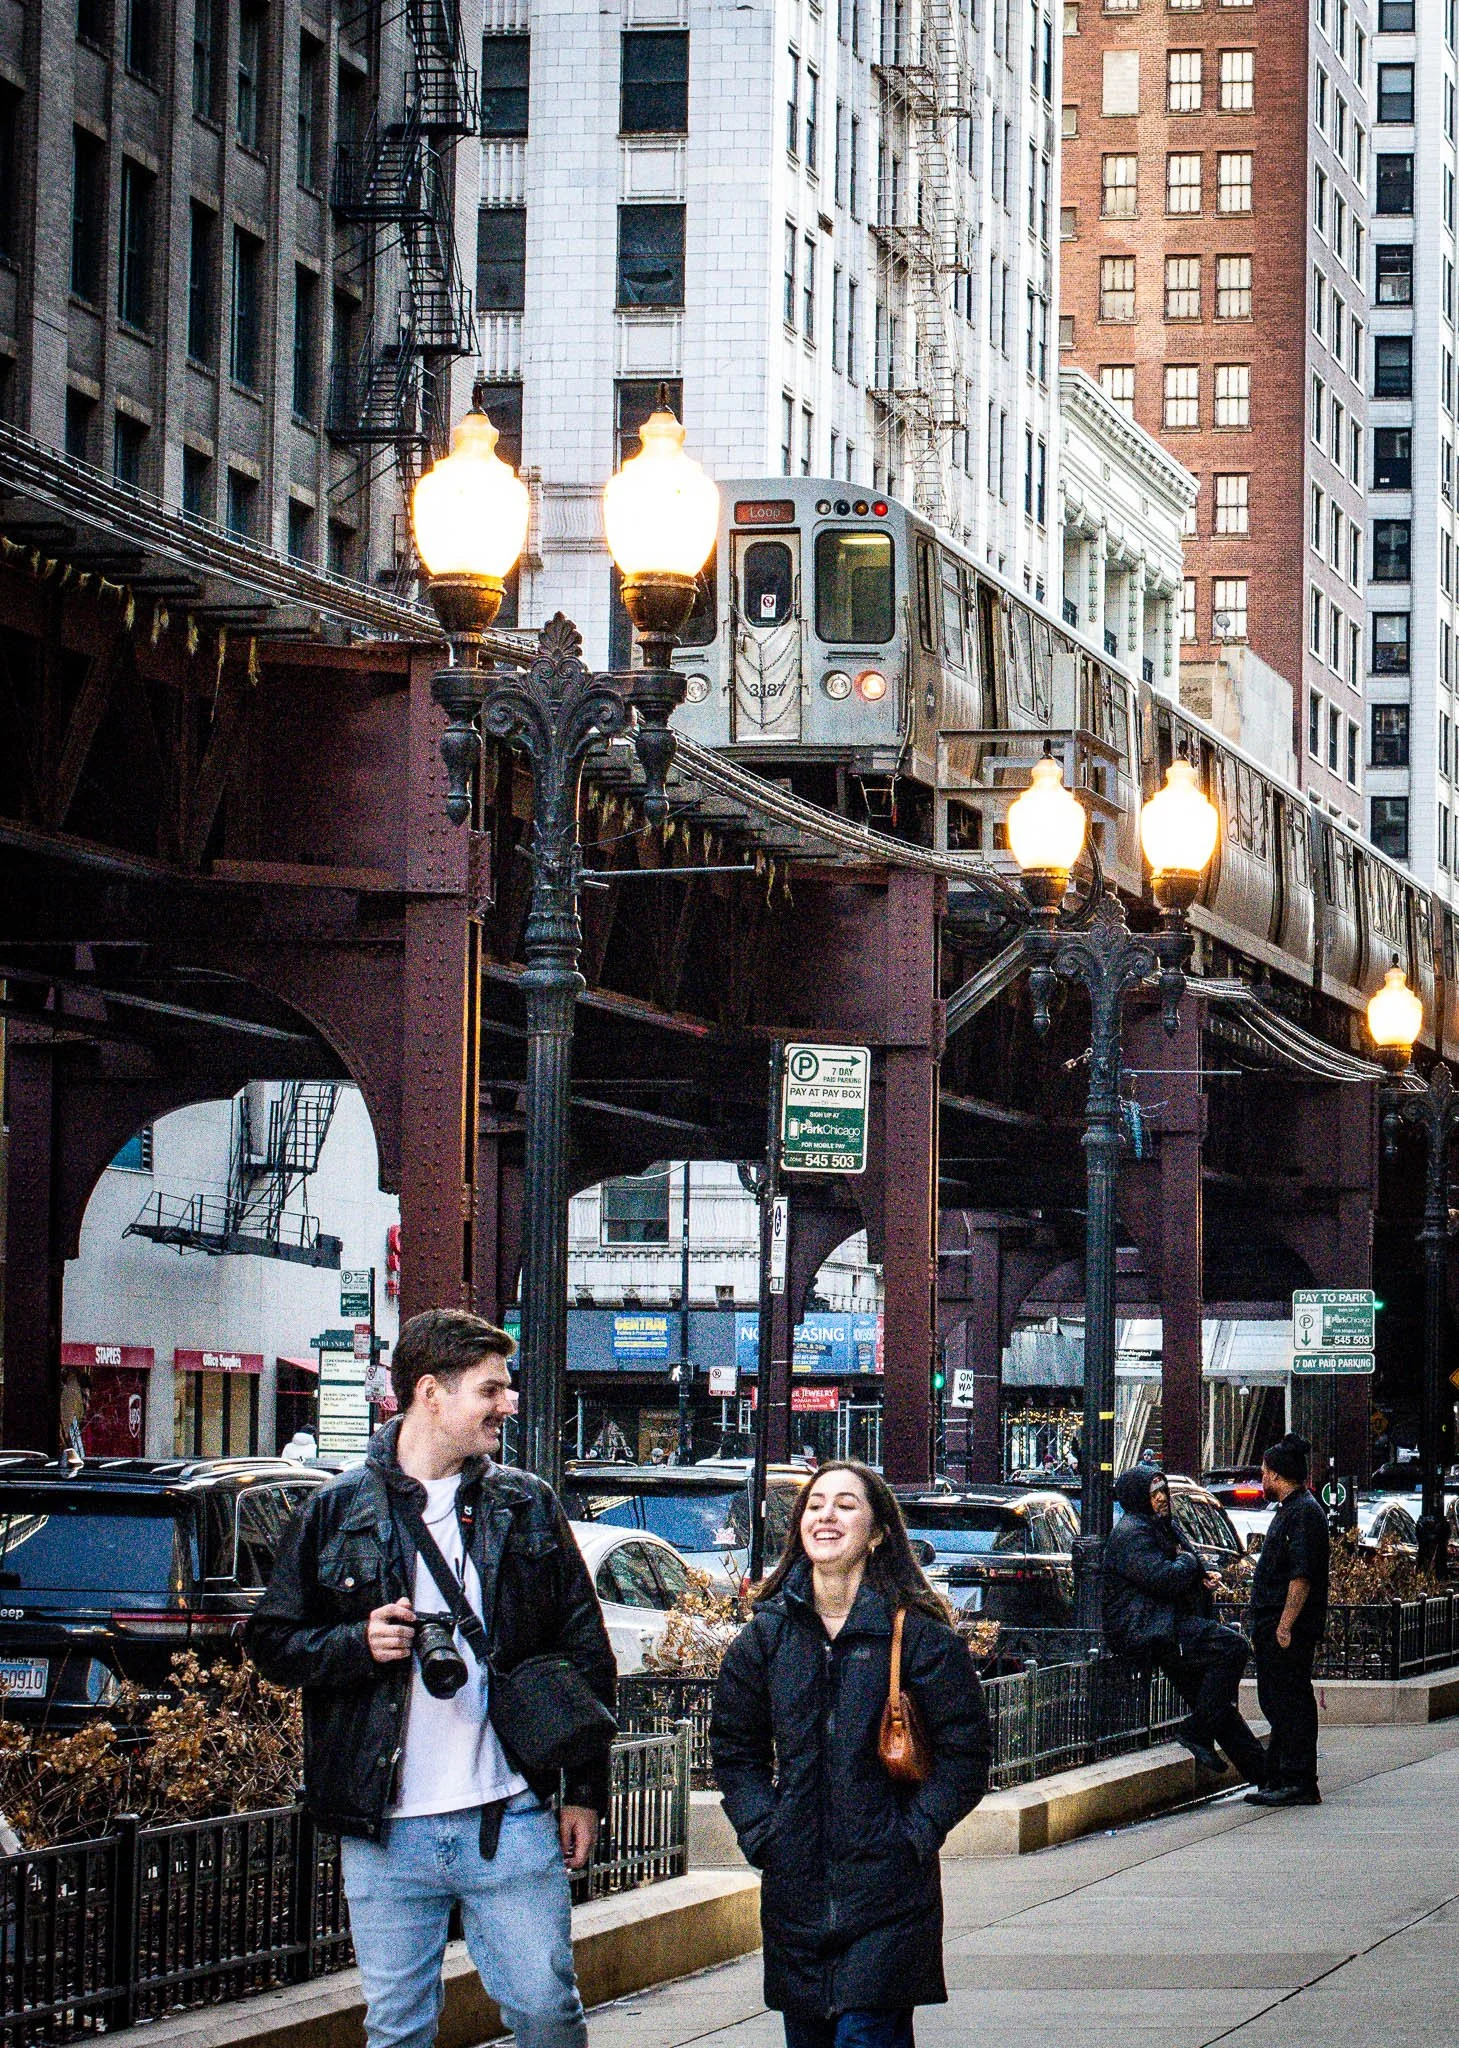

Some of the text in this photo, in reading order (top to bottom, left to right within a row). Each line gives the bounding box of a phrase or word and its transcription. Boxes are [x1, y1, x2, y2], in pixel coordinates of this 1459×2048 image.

[749, 507, 782, 519] Loop
[749, 683, 786, 698] 3187
[832, 1068, 854, 1077] 7 DAY
[790, 1088, 861, 1098] PAY AT PAY BOX
[800, 1122, 860, 1137] ParkChicago
[805, 1154, 829, 1167] 545
[831, 1155, 855, 1168] 503
[1300, 1293, 1368, 1303] PAY TO PARK
[792, 1327, 845, 1341] EASING
[1334, 1336, 1351, 1344] 545
[1352, 1336, 1370, 1344] 503
[95, 1346, 121, 1365] STAPLES
[220, 1354, 242, 1370] Supplies
[1295, 1359, 1371, 1368] 7 DAY PAID PARKING
[960, 1372, 973, 1382] ON
[959, 1383, 973, 1391] WA
[802, 1389, 835, 1398] JEWELRY
[0, 1608, 24, 1620] eep
